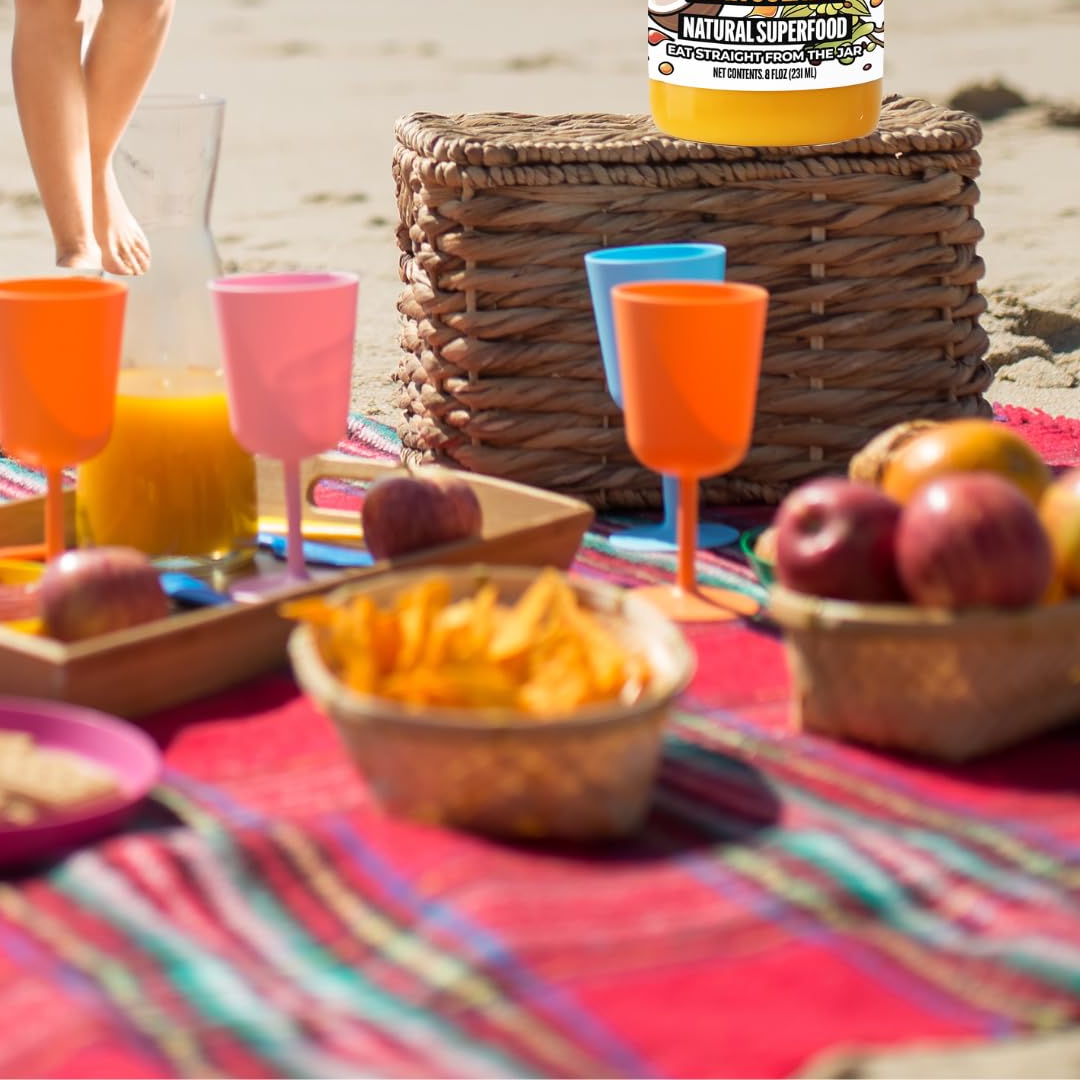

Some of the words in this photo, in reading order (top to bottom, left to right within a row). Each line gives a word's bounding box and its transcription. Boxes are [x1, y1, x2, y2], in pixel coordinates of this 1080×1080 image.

[682, 16, 755, 42] NATURAL
[756, 16, 848, 43] SUPERFOOD
[667, 44, 693, 58] EAT
[695, 48, 761, 62] STRAIGHT
[764, 50, 804, 62] FROM
[807, 49, 834, 60] THE
[836, 45, 862, 58] JAR
[713, 66, 726, 79] NET
[764, 68, 770, 80] 8
[788, 67, 803, 81] (231
[804, 67, 817, 80] ML)
